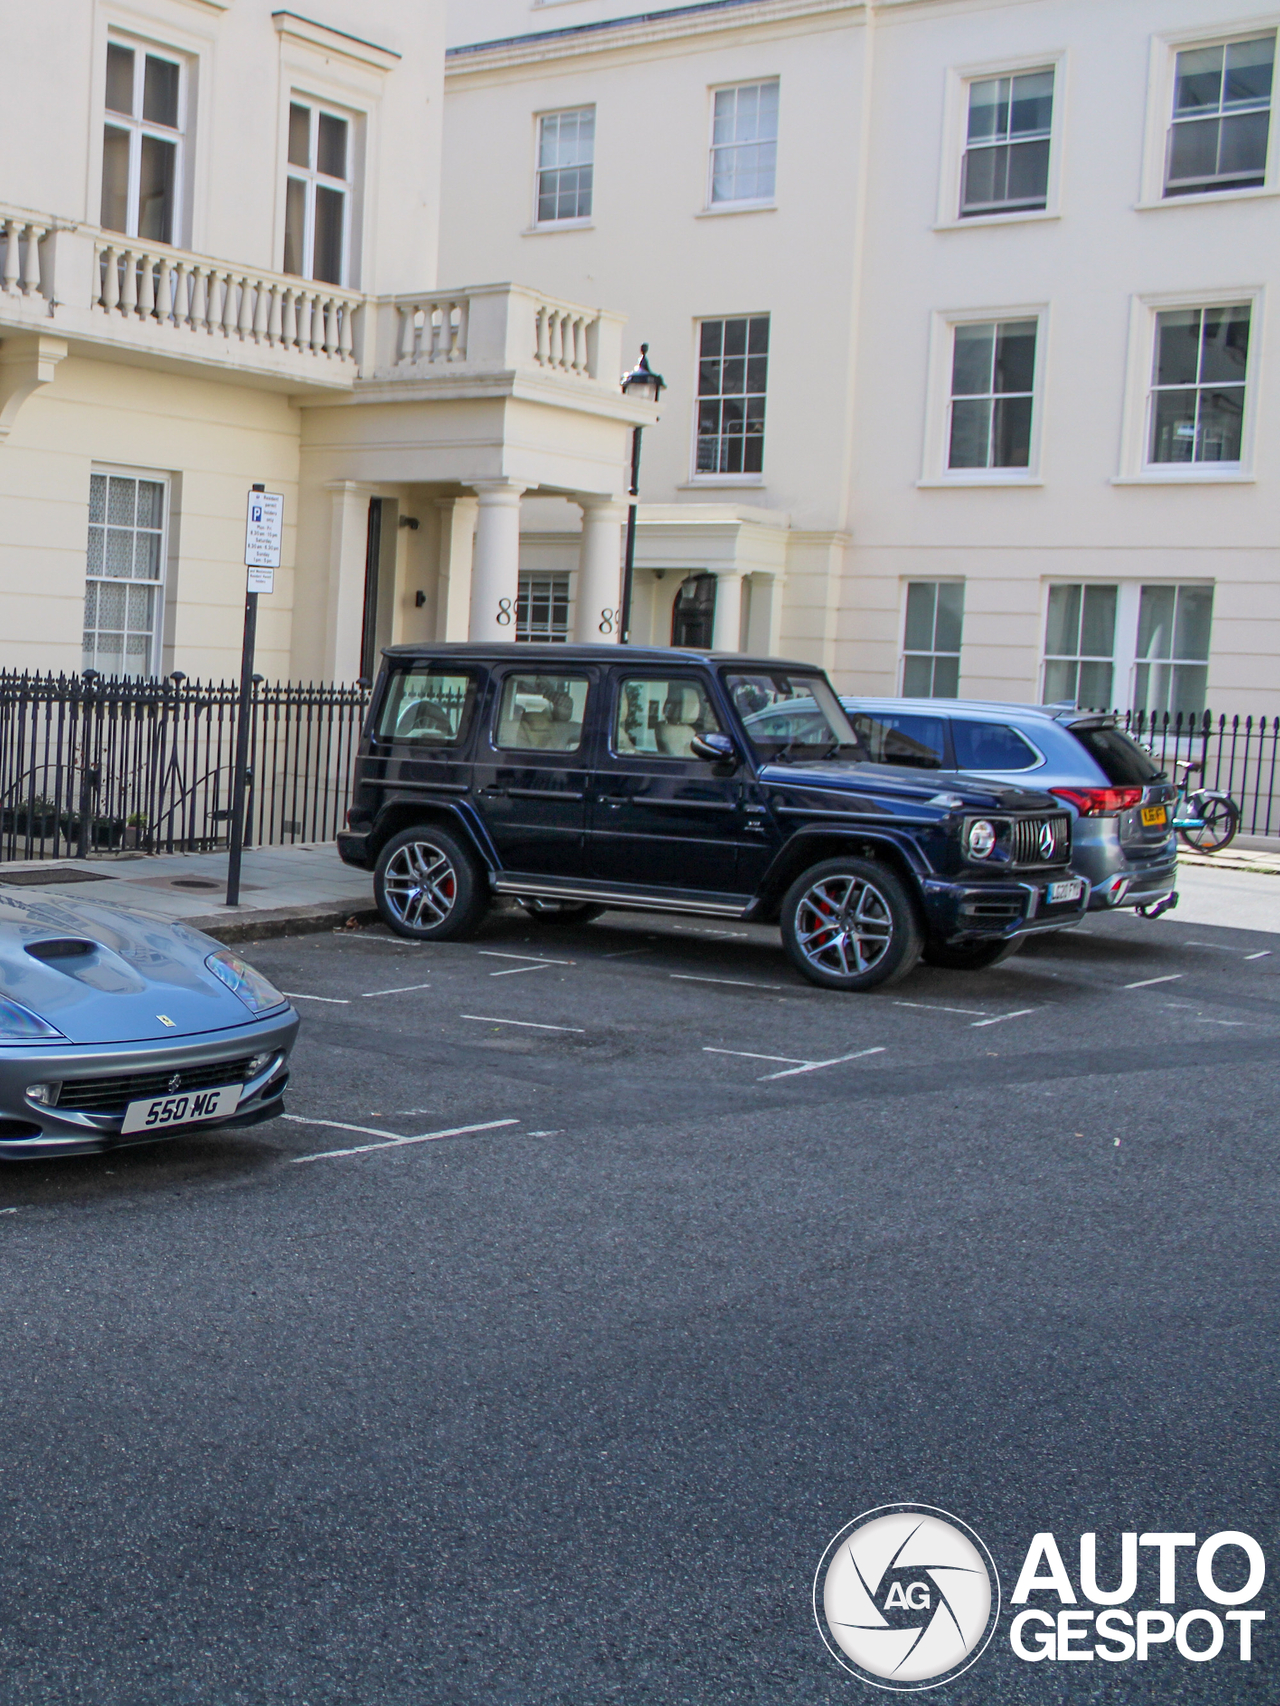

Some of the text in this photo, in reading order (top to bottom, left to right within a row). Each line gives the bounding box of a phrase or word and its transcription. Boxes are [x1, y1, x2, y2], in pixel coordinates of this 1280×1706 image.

[598, 607, 620, 634] 8
[145, 1091, 219, 1127] 550 MG
